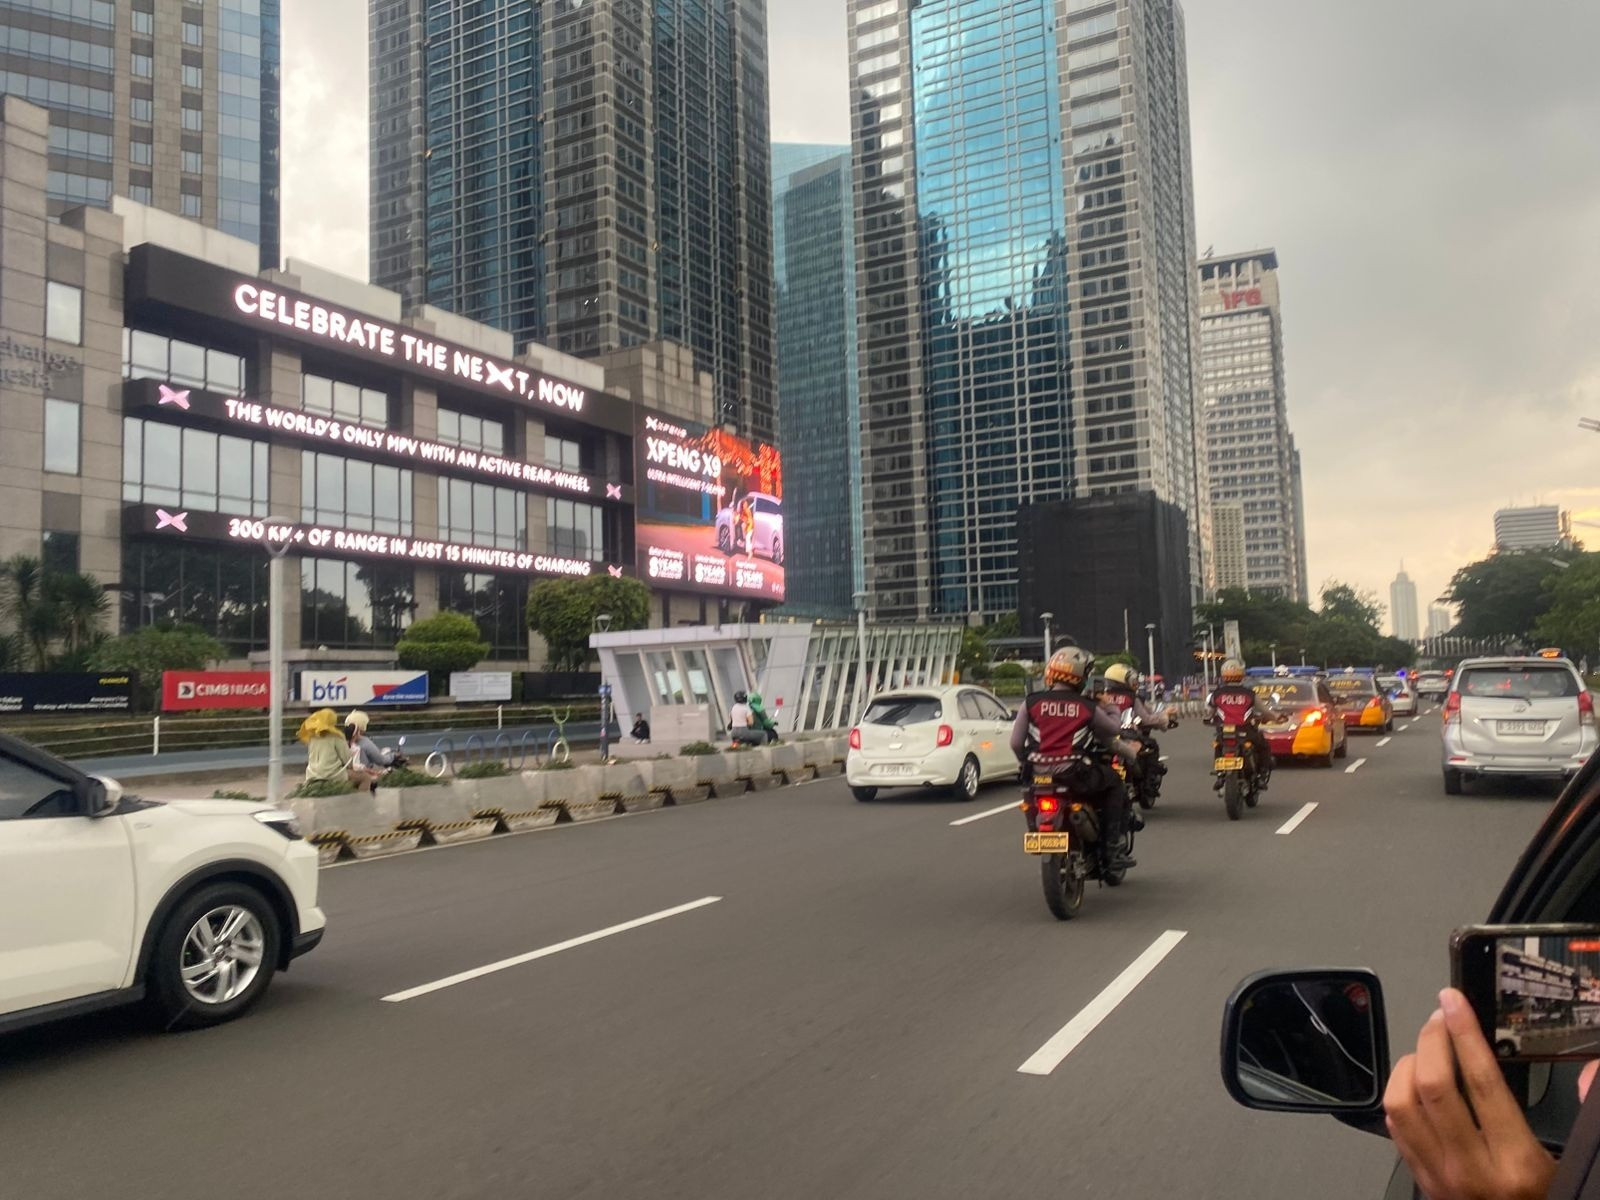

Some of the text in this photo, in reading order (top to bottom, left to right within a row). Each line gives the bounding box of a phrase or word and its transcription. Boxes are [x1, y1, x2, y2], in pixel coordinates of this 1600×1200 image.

[234, 283, 395, 355] CELEBRATE
[400, 333, 448, 371] THE
[538, 378, 585, 412] NOW
[226, 399, 591, 493] THE WORLD'S ONLY MPV WITH AN ACTIVE REAR-WHEEL
[646, 436, 722, 478] XPENG X9
[229, 518, 265, 540] 300
[308, 528, 331, 547] OF
[335, 531, 387, 553] RANGE
[390, 538, 407, 555] IN
[409, 541, 443, 559] JUST
[445, 545, 460, 562] 15
[462, 547, 515, 568] MINUTES
[517, 554, 533, 569] OF
[534, 556, 591, 576] CHARGING
[196, 682, 267, 696] CIMB NIAGA
[313, 676, 347, 700] btn
[1221, 695, 1246, 705] POLISI
[1041, 702, 1080, 717] POLISI
